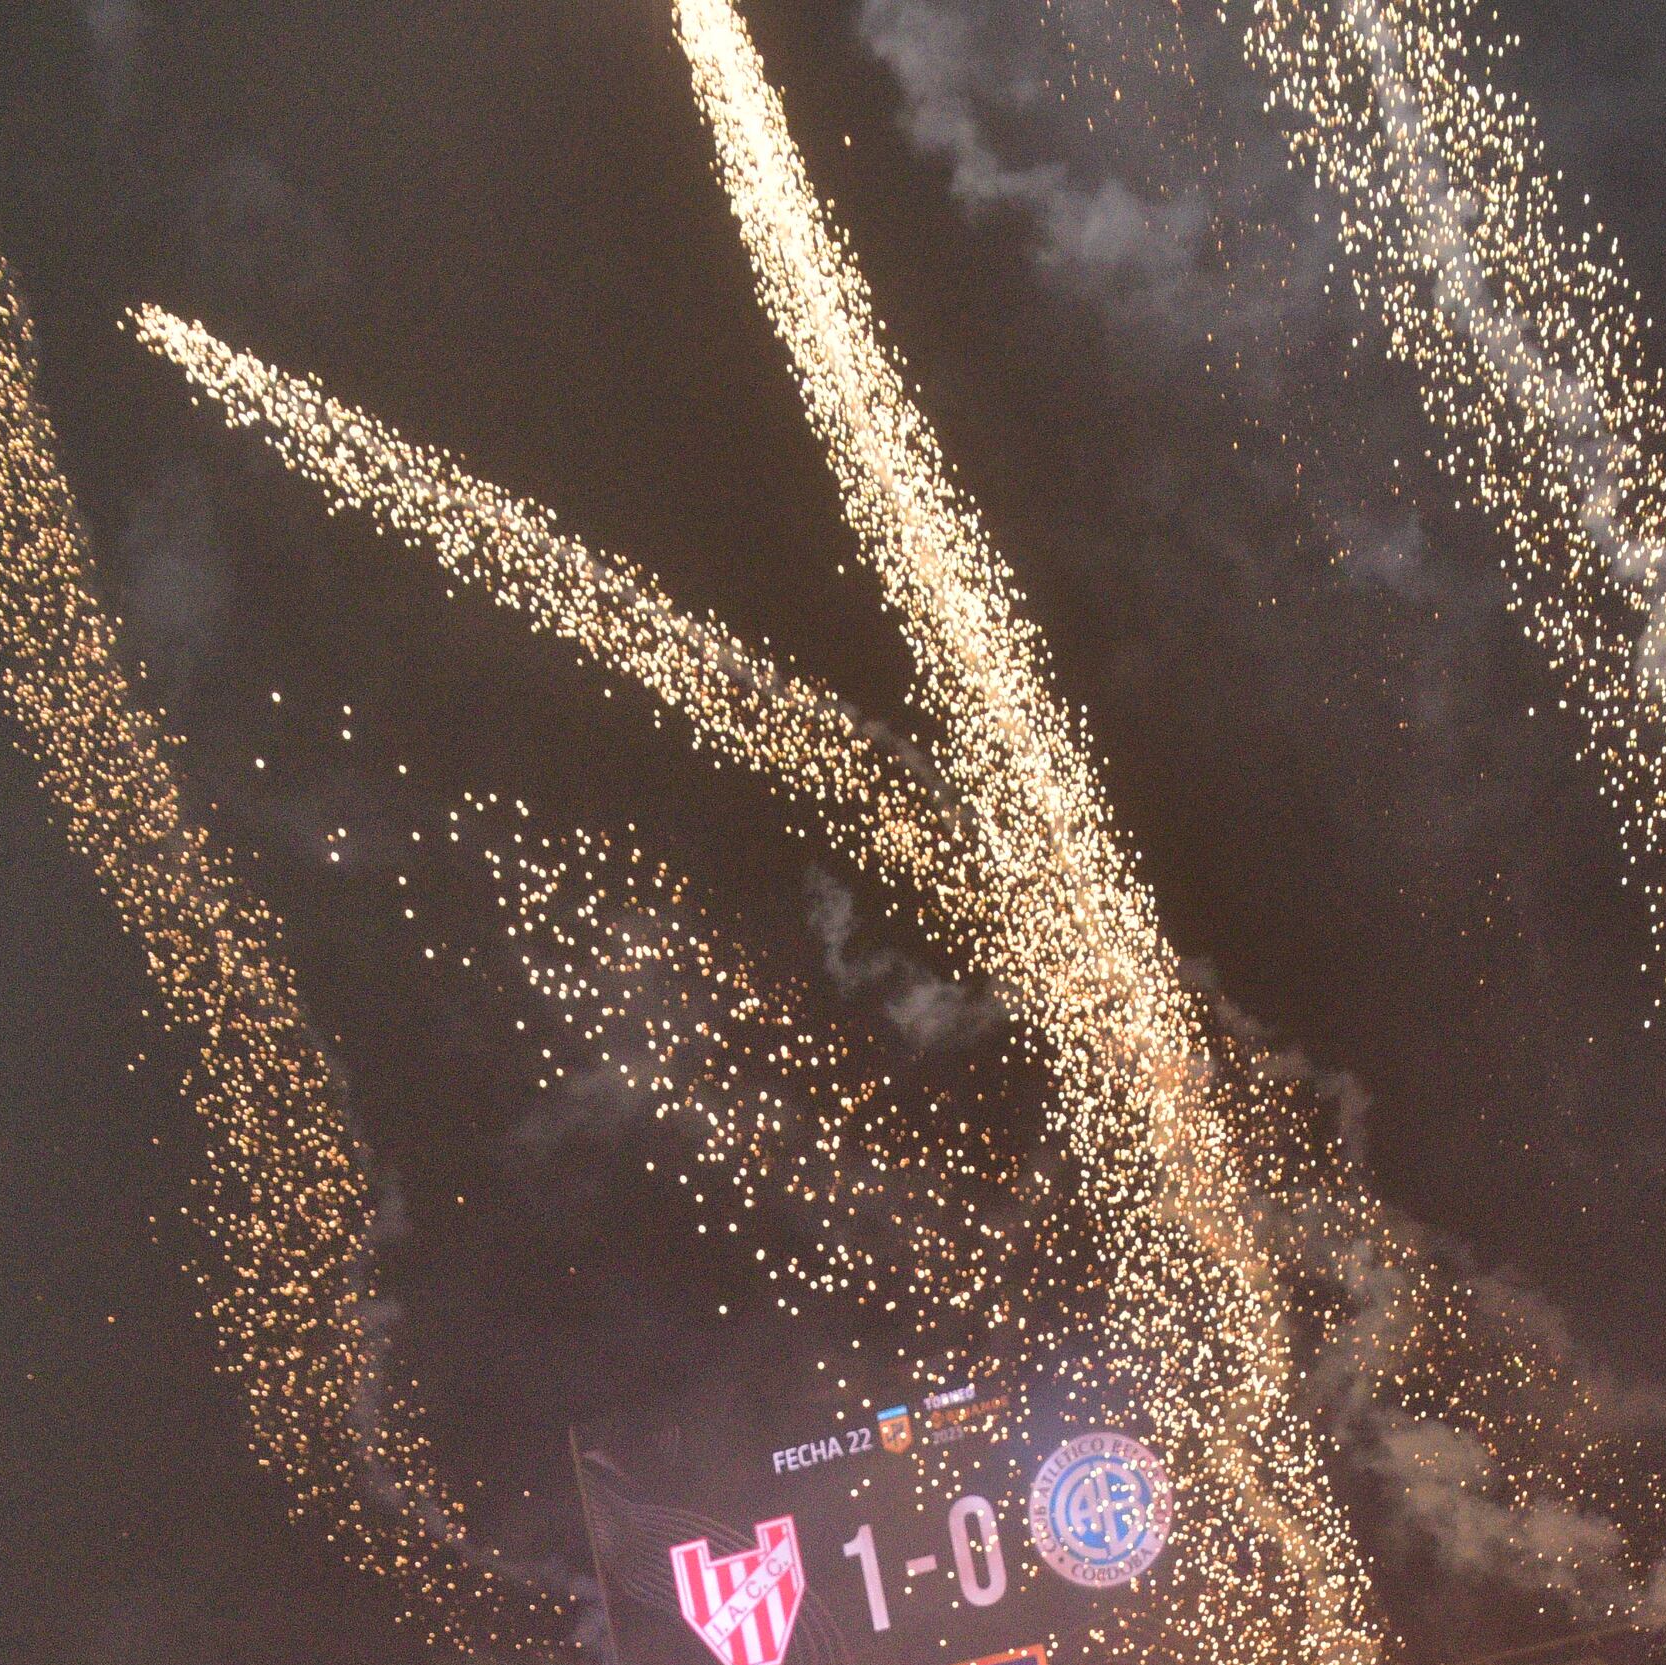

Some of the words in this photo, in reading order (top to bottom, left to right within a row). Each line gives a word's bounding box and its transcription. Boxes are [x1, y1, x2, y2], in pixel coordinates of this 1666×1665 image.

[923, 1387, 975, 1410] TORNEO
[773, 1437, 844, 1474] FECHA
[846, 1428, 873, 1454] 22
